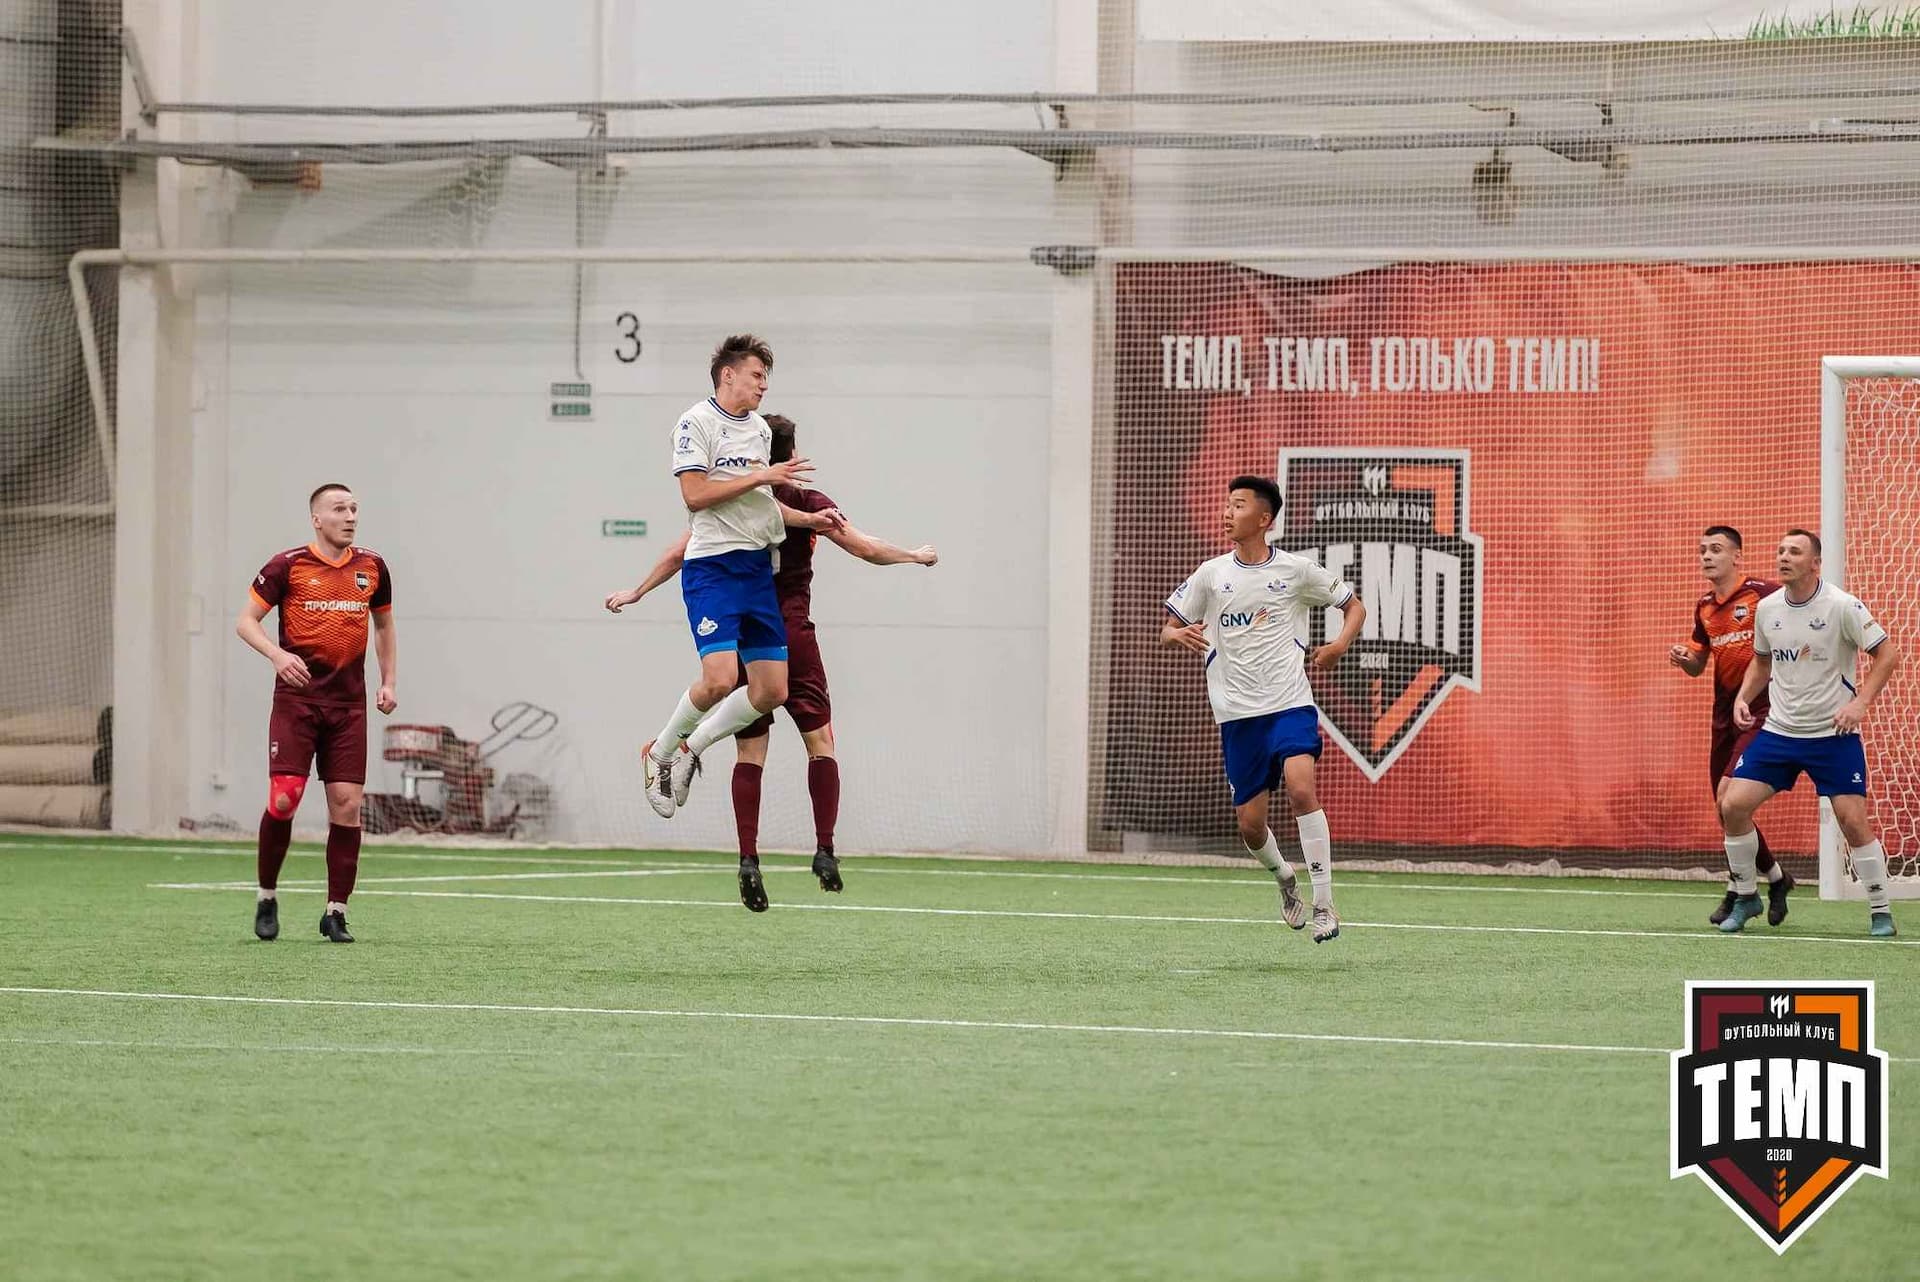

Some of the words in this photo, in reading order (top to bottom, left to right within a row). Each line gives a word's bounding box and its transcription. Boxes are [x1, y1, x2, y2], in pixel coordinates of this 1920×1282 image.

[616, 312, 641, 363] 3
[1161, 335, 1251, 395] ТЕМП,
[1265, 335, 1358, 397] ТЕМП,
[1370, 336, 1496, 393] ТОЛЬКО
[1506, 337, 1600, 393] ТЕМП!
[1403, 502, 1430, 523] КЛУБ
[1221, 612, 1254, 627] GNV
[1360, 652, 1389, 669] 2020
[1772, 648, 1800, 661] GNV
